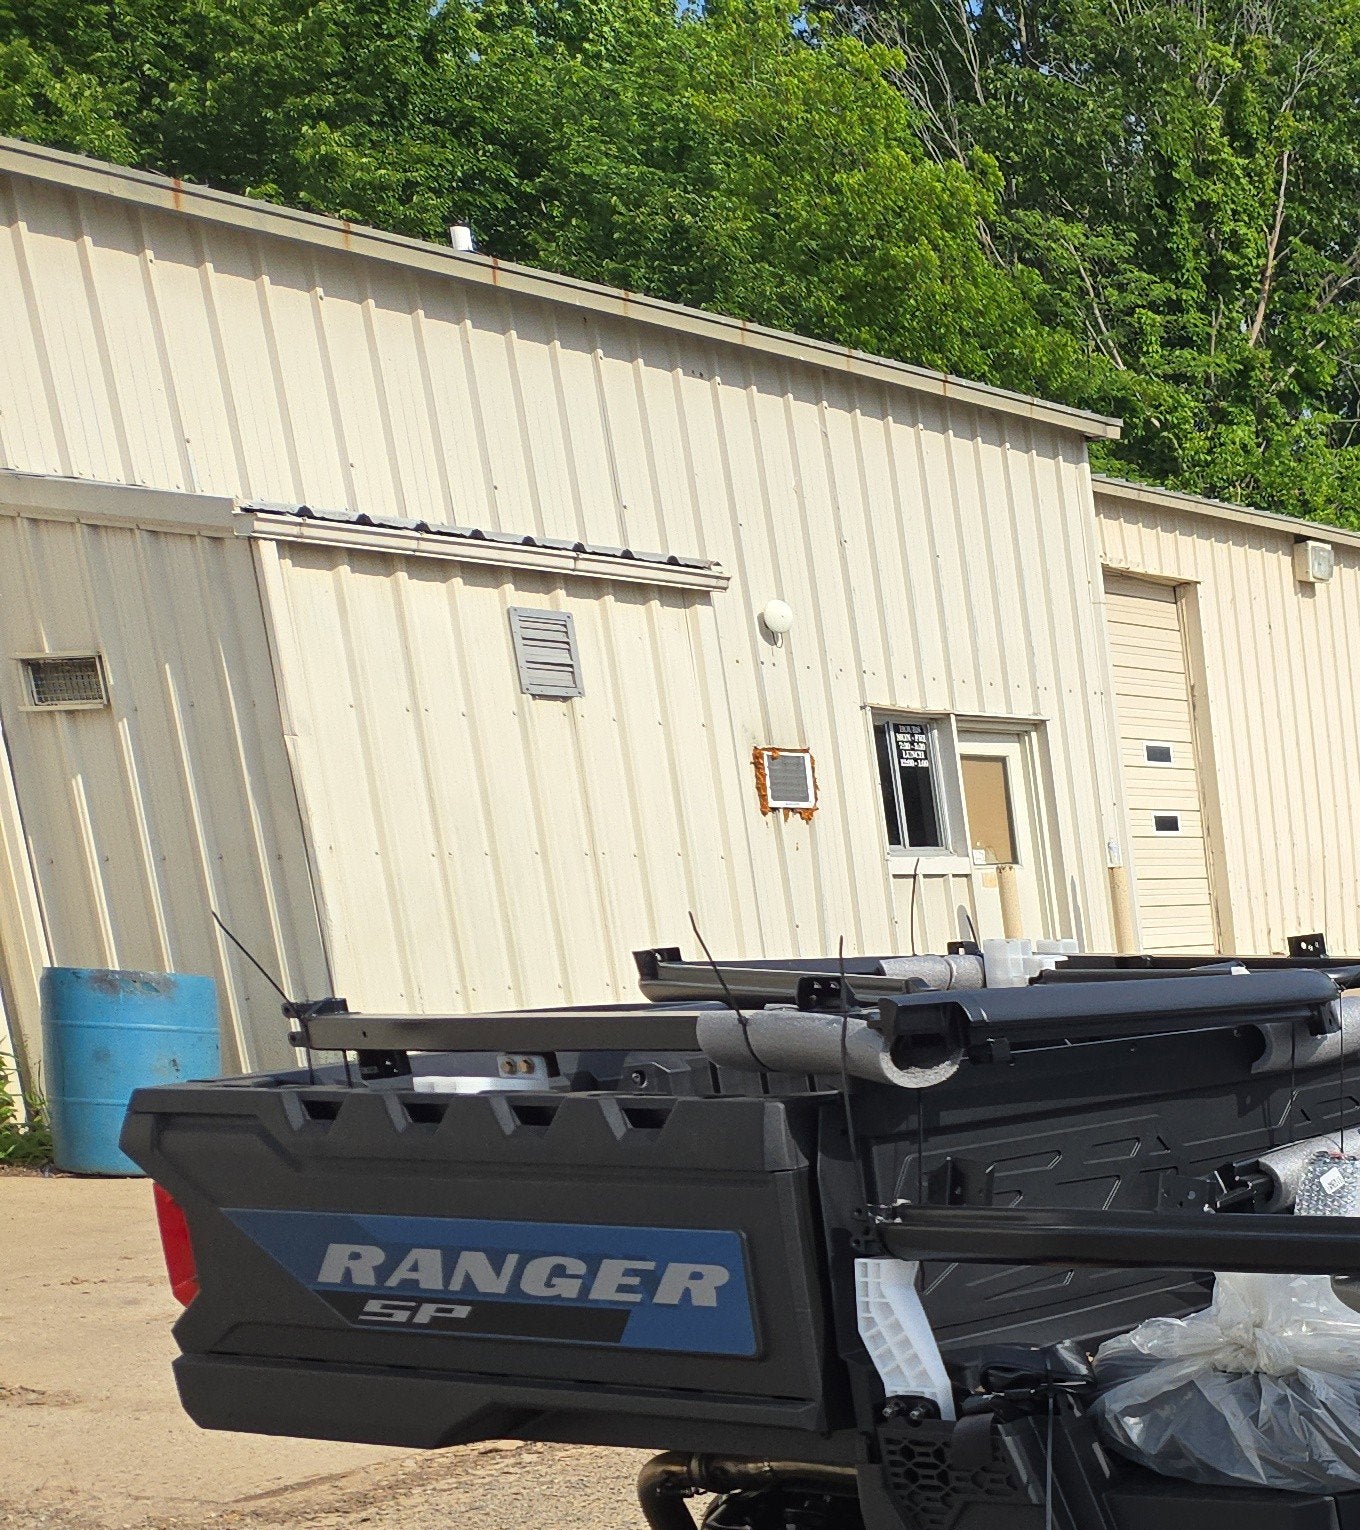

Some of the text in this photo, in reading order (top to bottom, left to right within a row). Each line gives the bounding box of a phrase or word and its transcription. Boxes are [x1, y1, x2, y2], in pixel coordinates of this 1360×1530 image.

[902, 750, 924, 758] LUNCH
[318, 1243, 730, 1307] RANGER
[358, 1300, 472, 1323] SP
